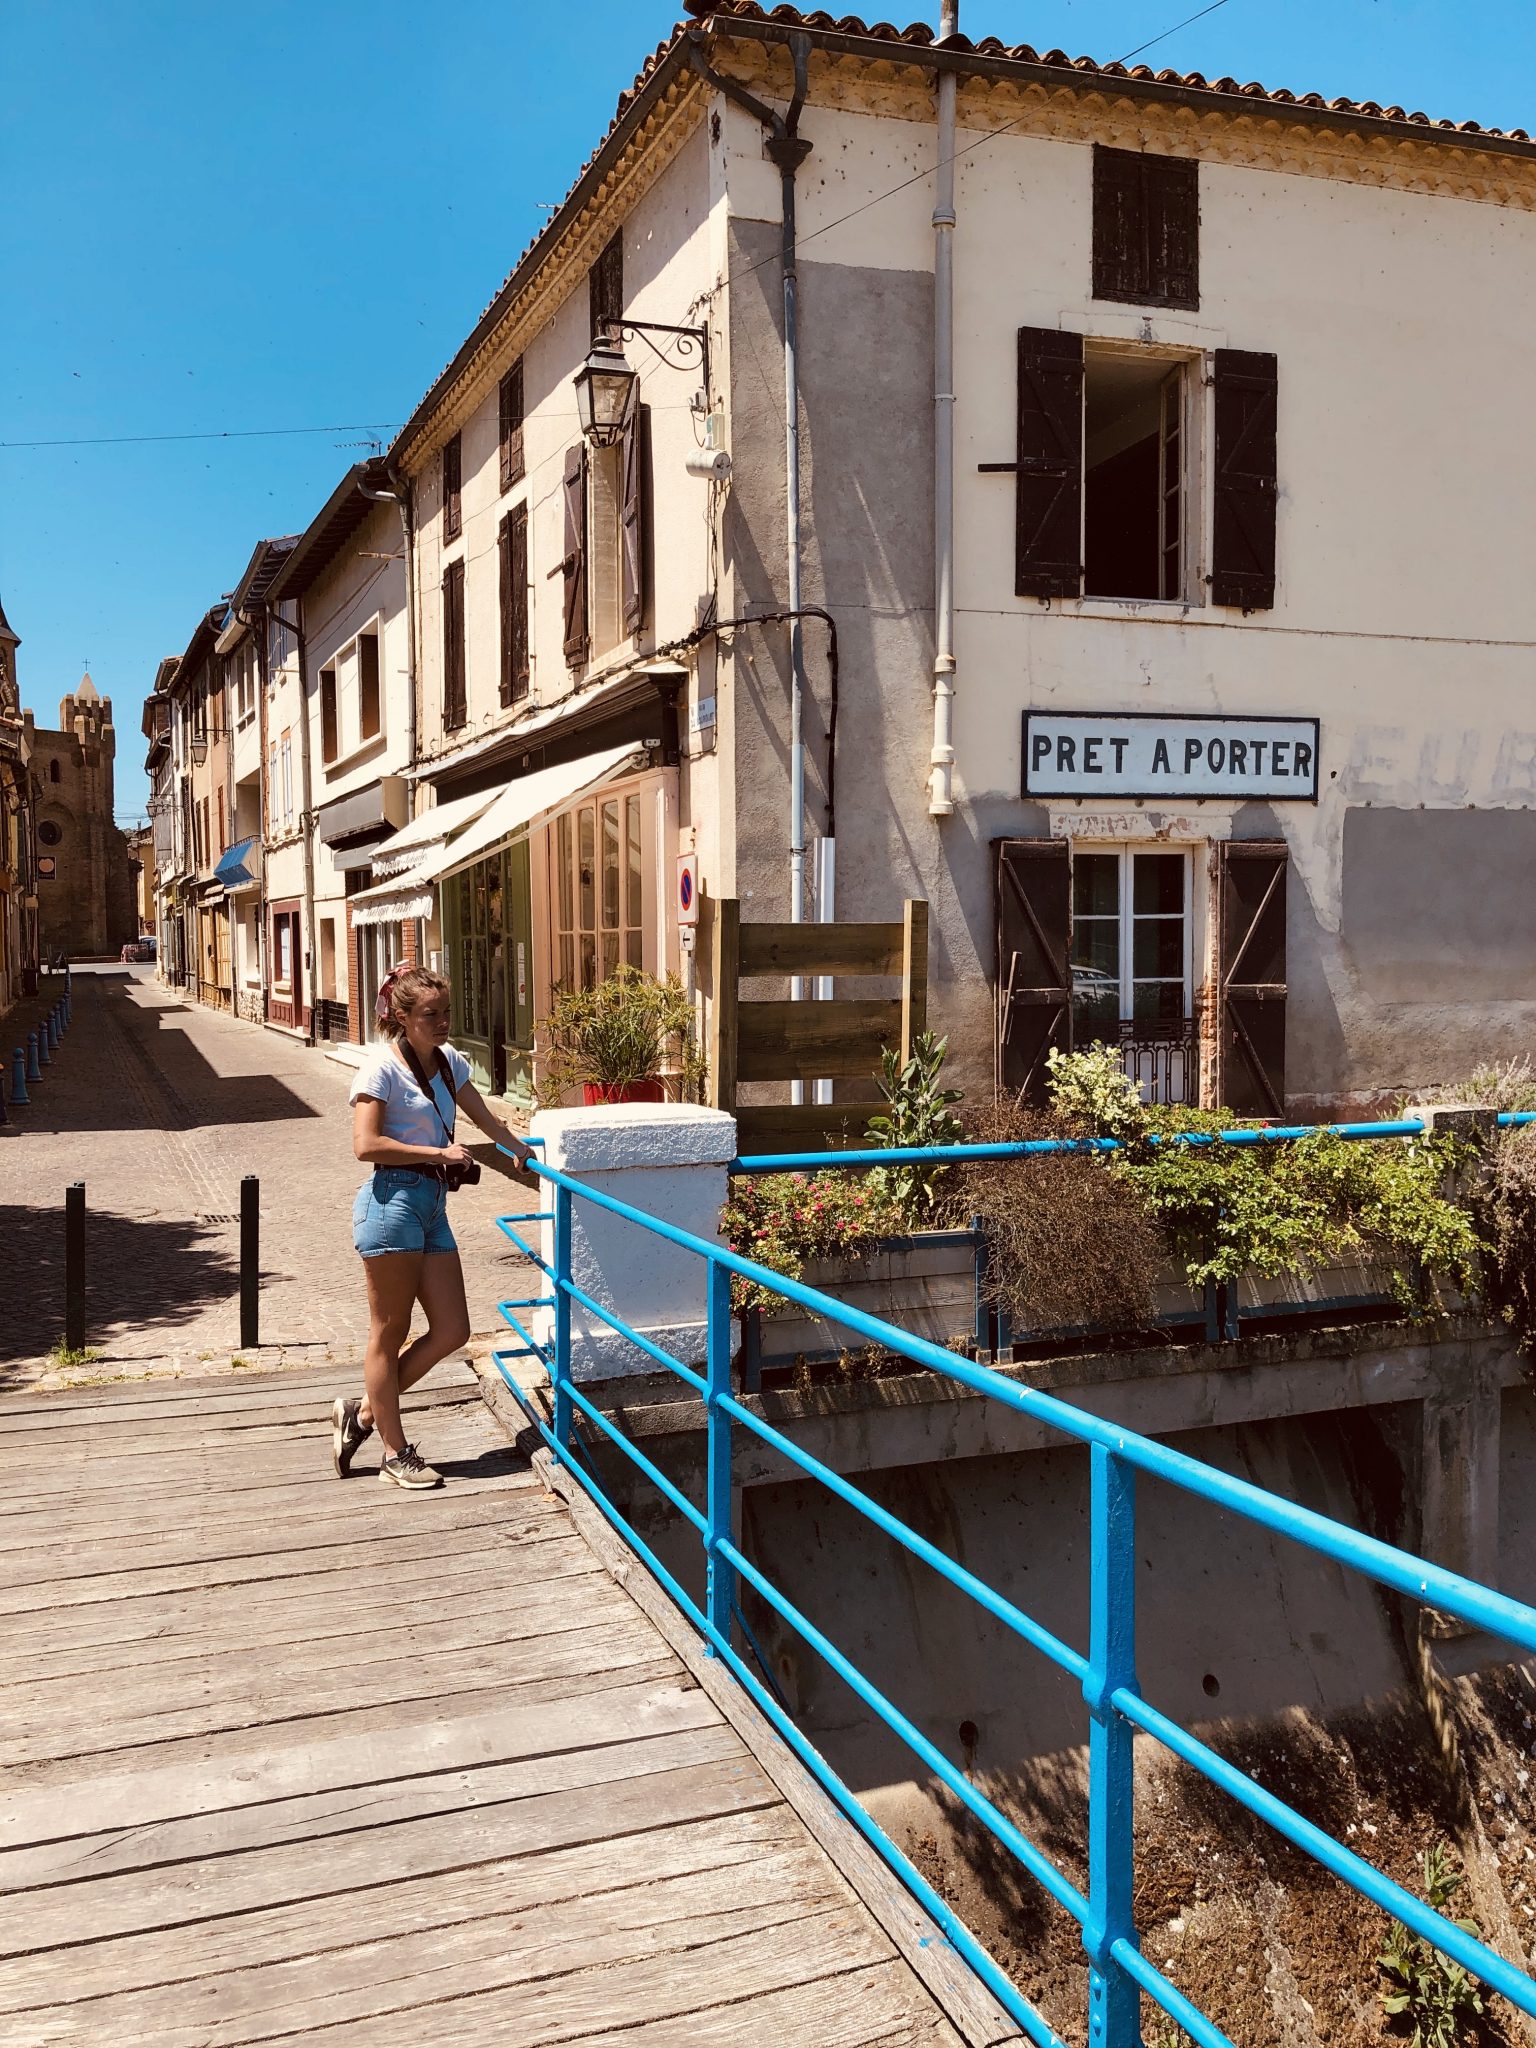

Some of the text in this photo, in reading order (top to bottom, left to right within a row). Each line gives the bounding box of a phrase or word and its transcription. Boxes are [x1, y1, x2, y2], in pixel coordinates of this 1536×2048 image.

[1032, 735, 1312, 777] PRET A PORTER
